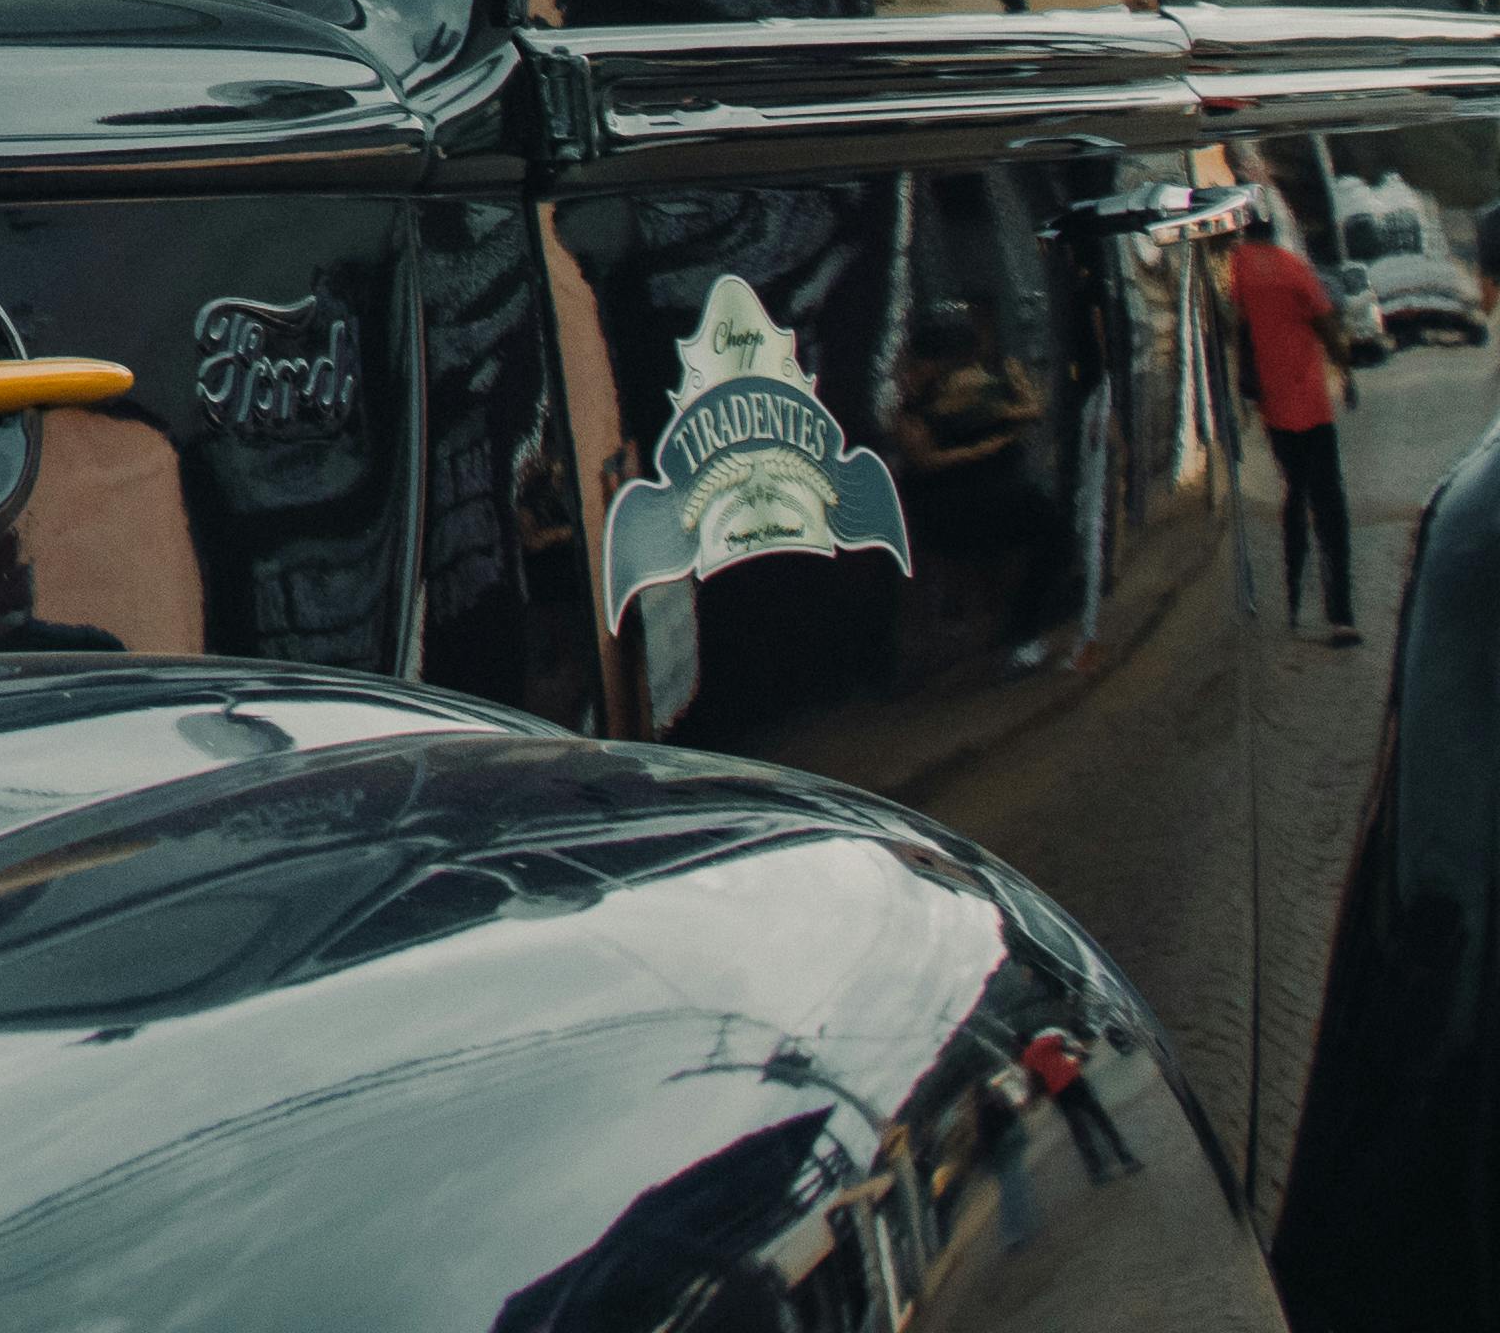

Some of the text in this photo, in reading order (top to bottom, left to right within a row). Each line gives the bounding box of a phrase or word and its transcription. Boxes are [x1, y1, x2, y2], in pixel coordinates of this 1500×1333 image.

[194, 294, 355, 423] Ford
[711, 319, 767, 371] Chopp
[674, 390, 829, 475] TIRADENTES
